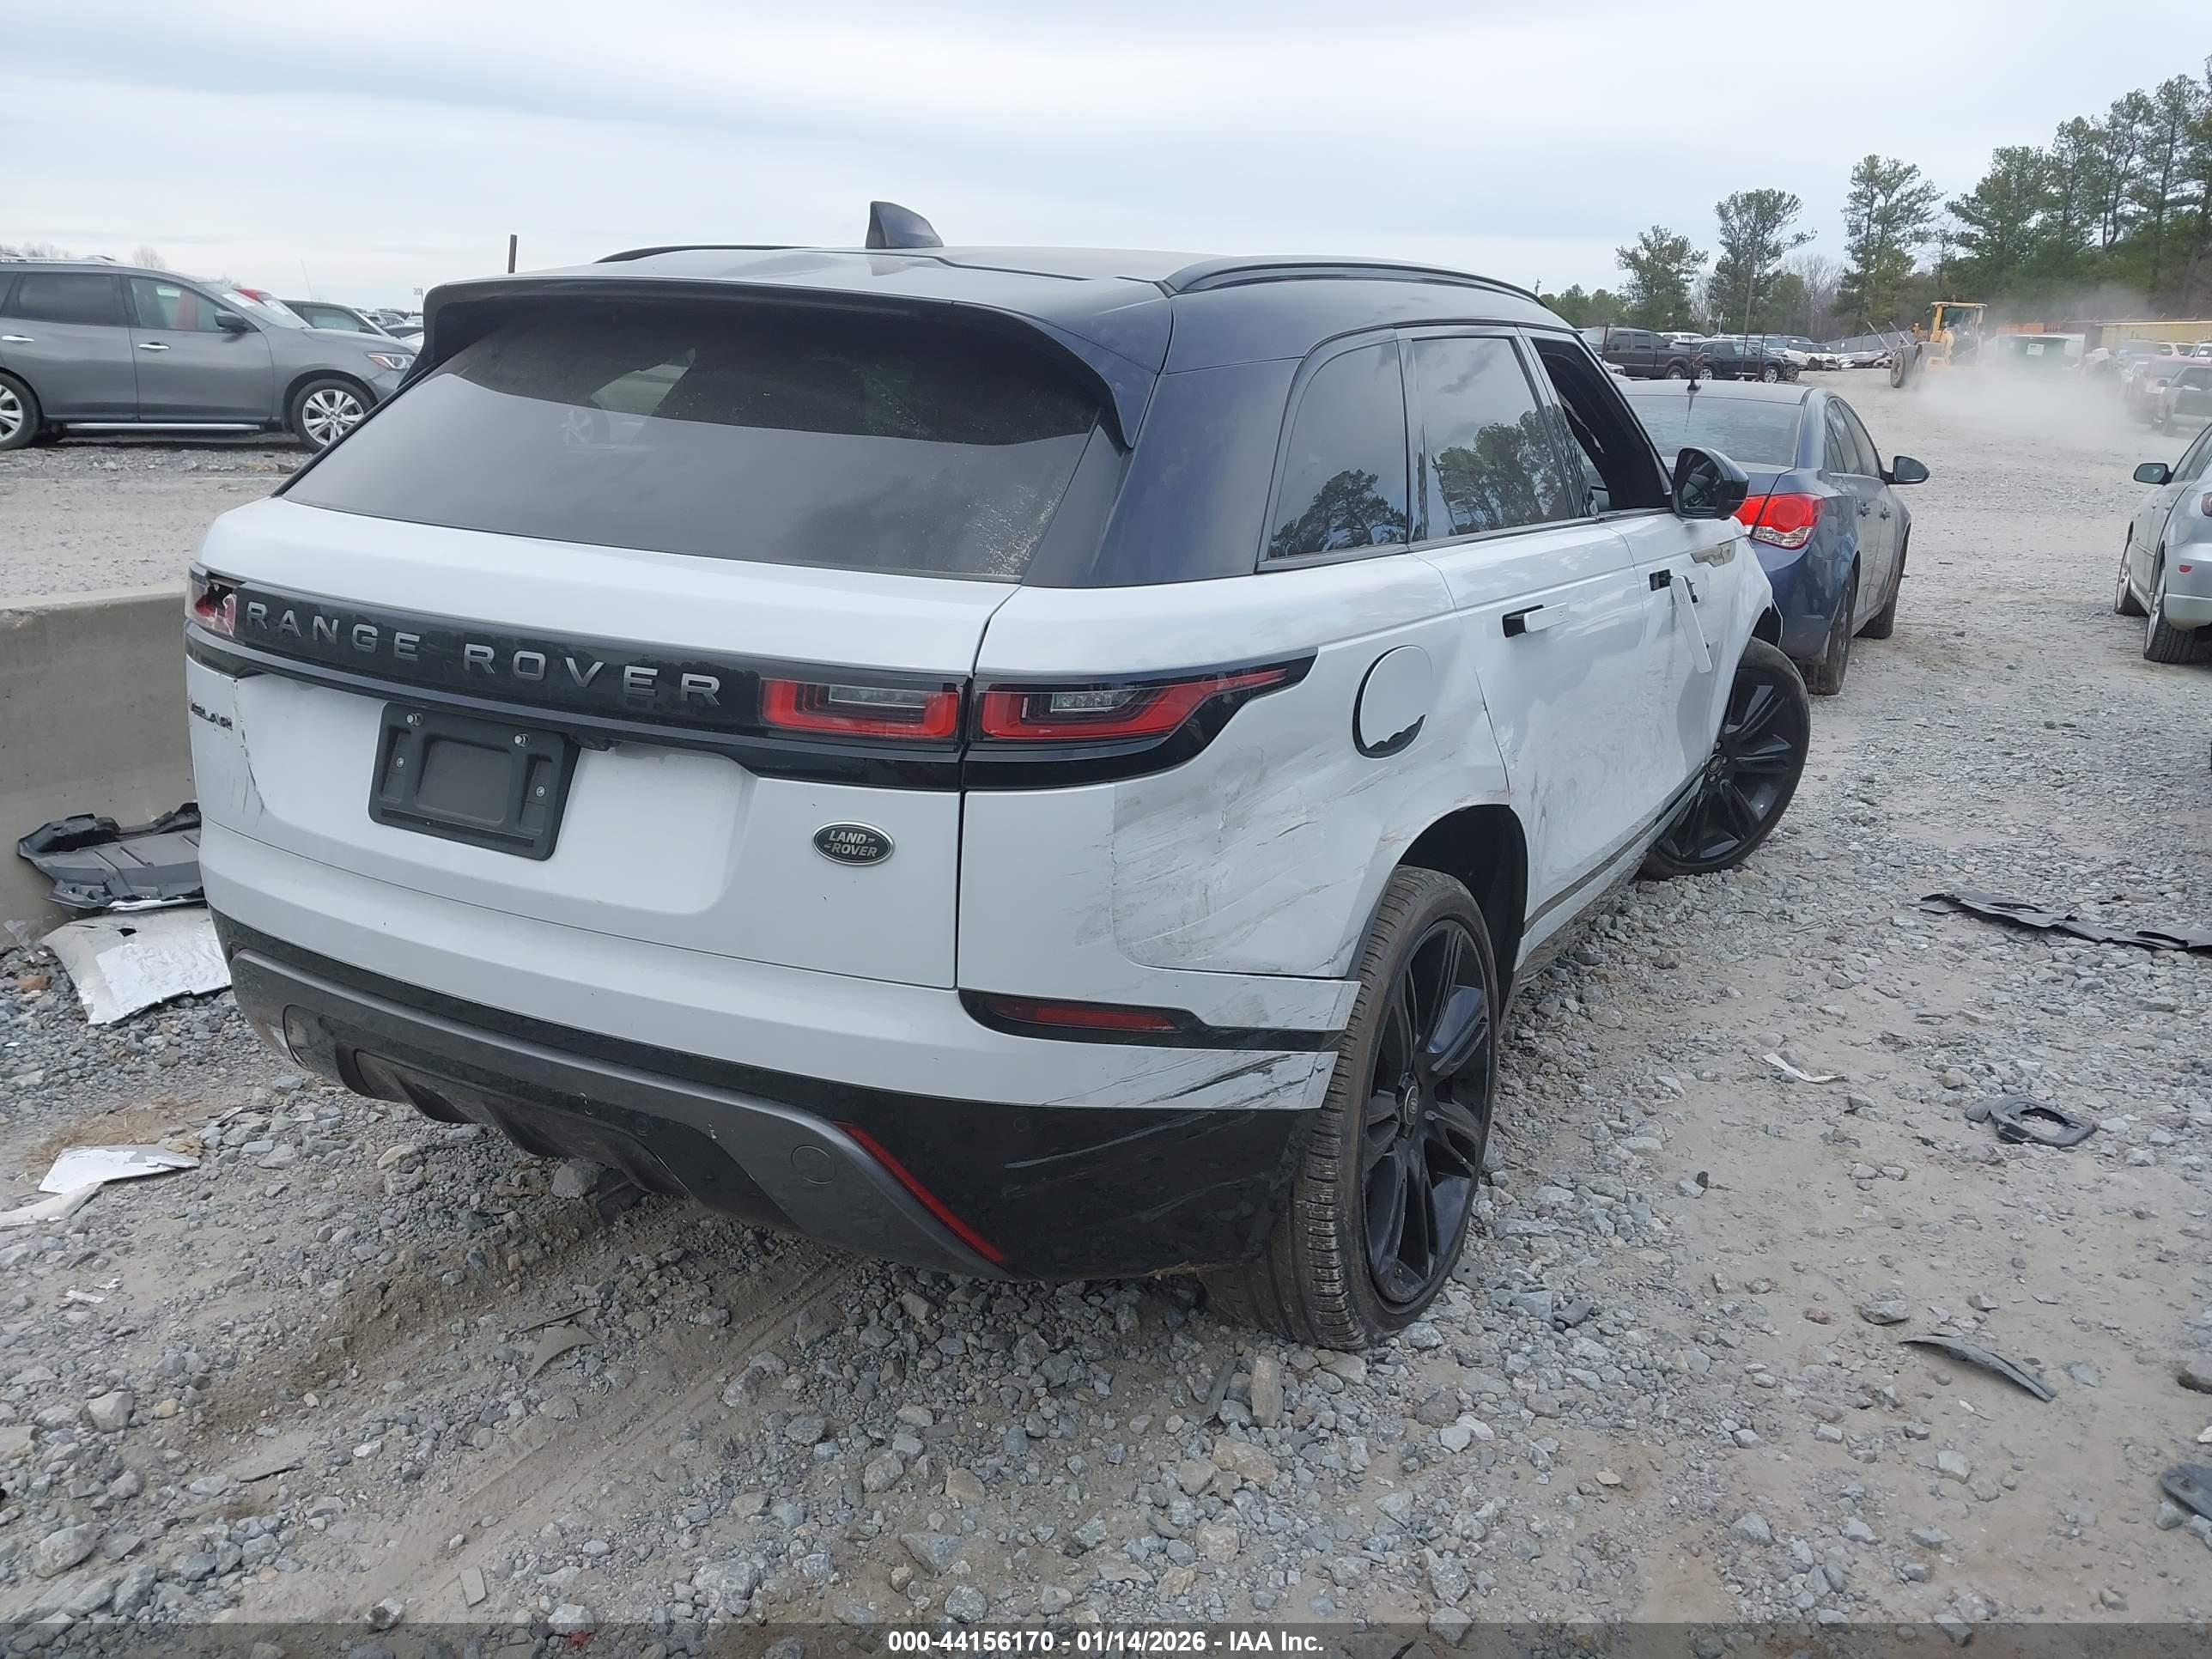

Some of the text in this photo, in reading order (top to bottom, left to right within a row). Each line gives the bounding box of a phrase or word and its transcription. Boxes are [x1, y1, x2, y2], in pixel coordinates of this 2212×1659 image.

[246, 601, 720, 707] RANGE ROVER
[829, 830, 866, 844] LAND
[831, 843, 878, 857] ROVER
